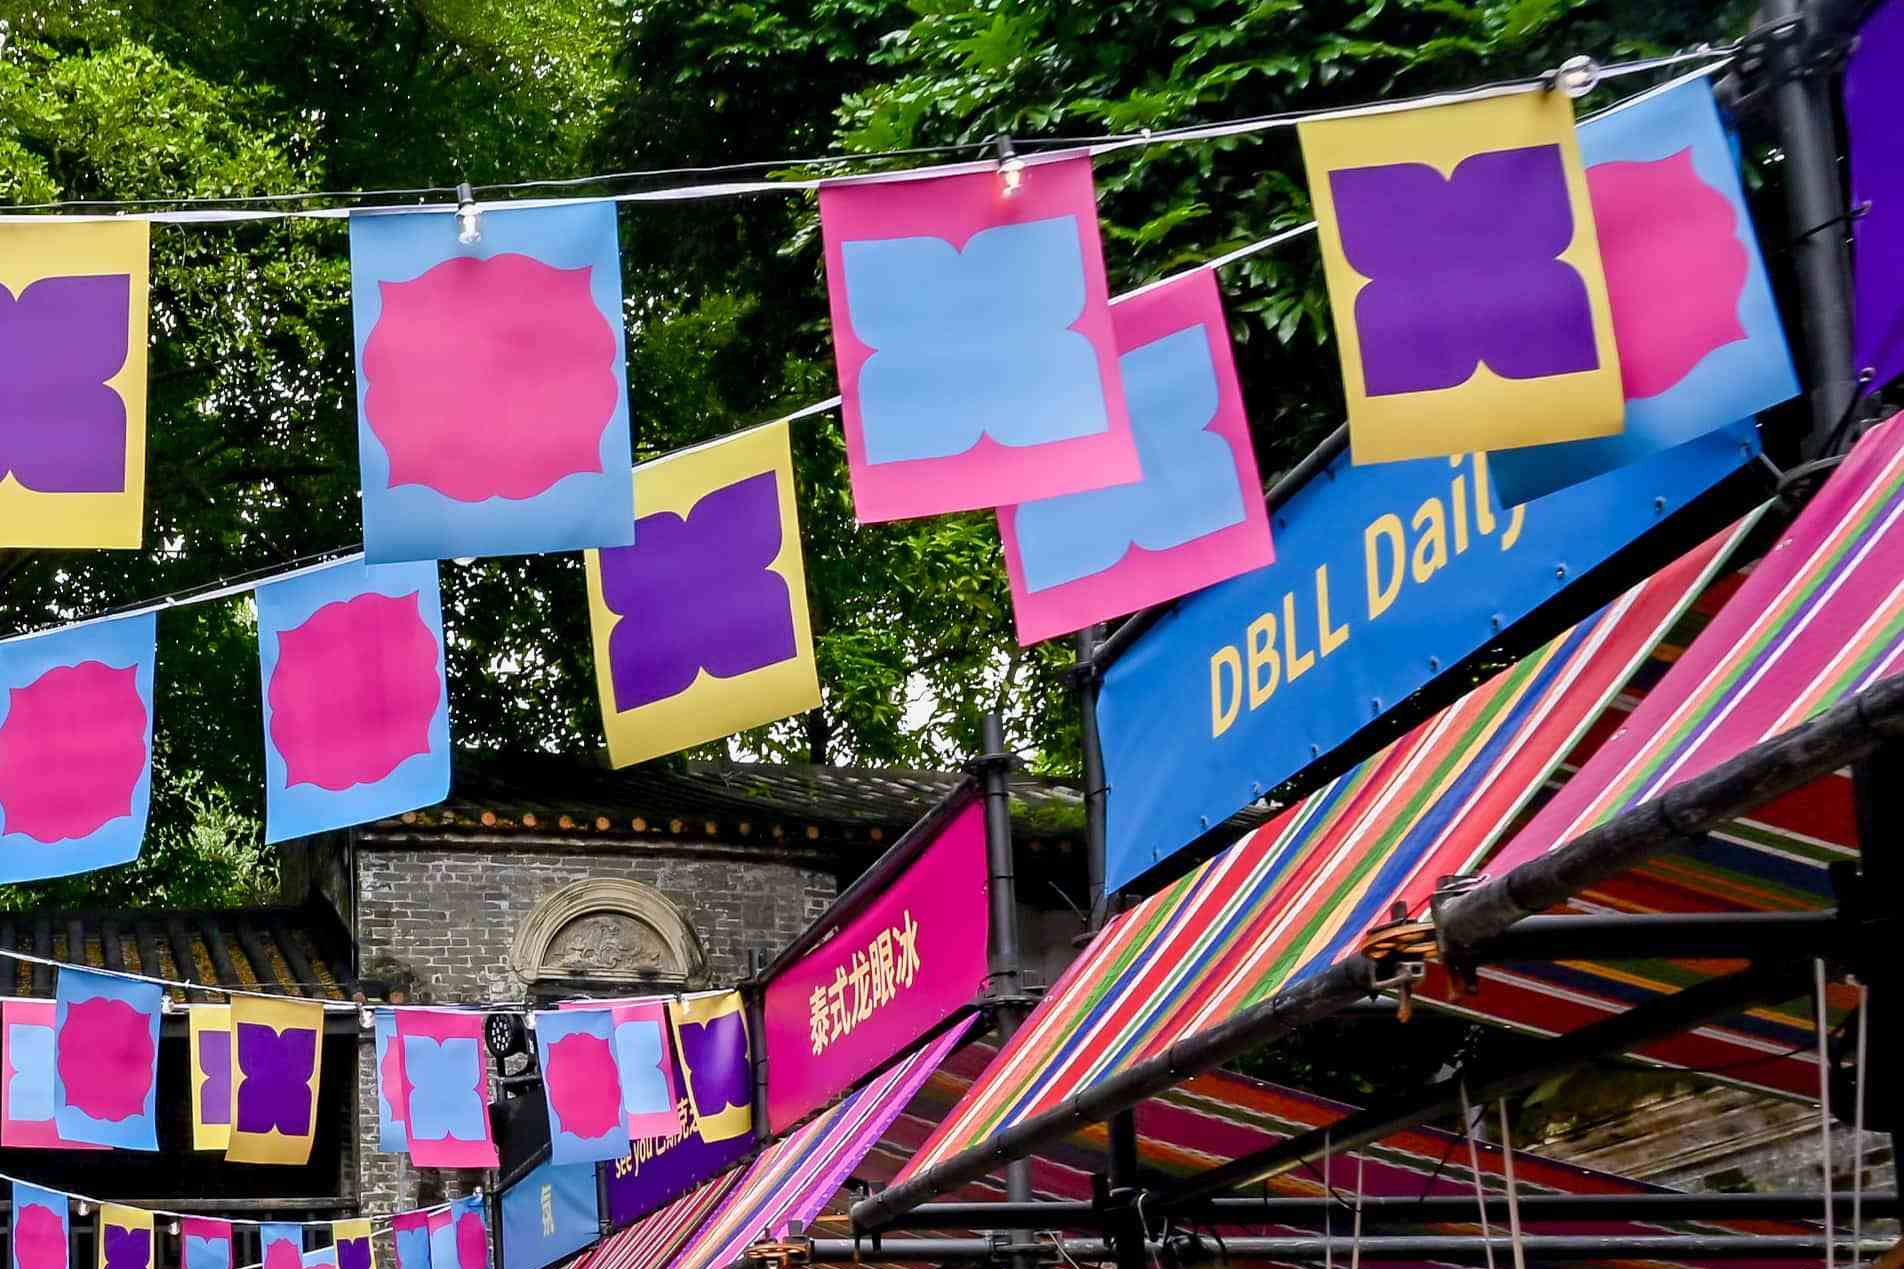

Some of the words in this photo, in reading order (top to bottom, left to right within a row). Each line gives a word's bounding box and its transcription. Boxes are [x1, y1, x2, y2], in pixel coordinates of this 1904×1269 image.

[1209, 564, 1350, 739] DBLL
[808, 909, 921, 1057] 泰式龙眼冰
[632, 1136, 653, 1177] you
